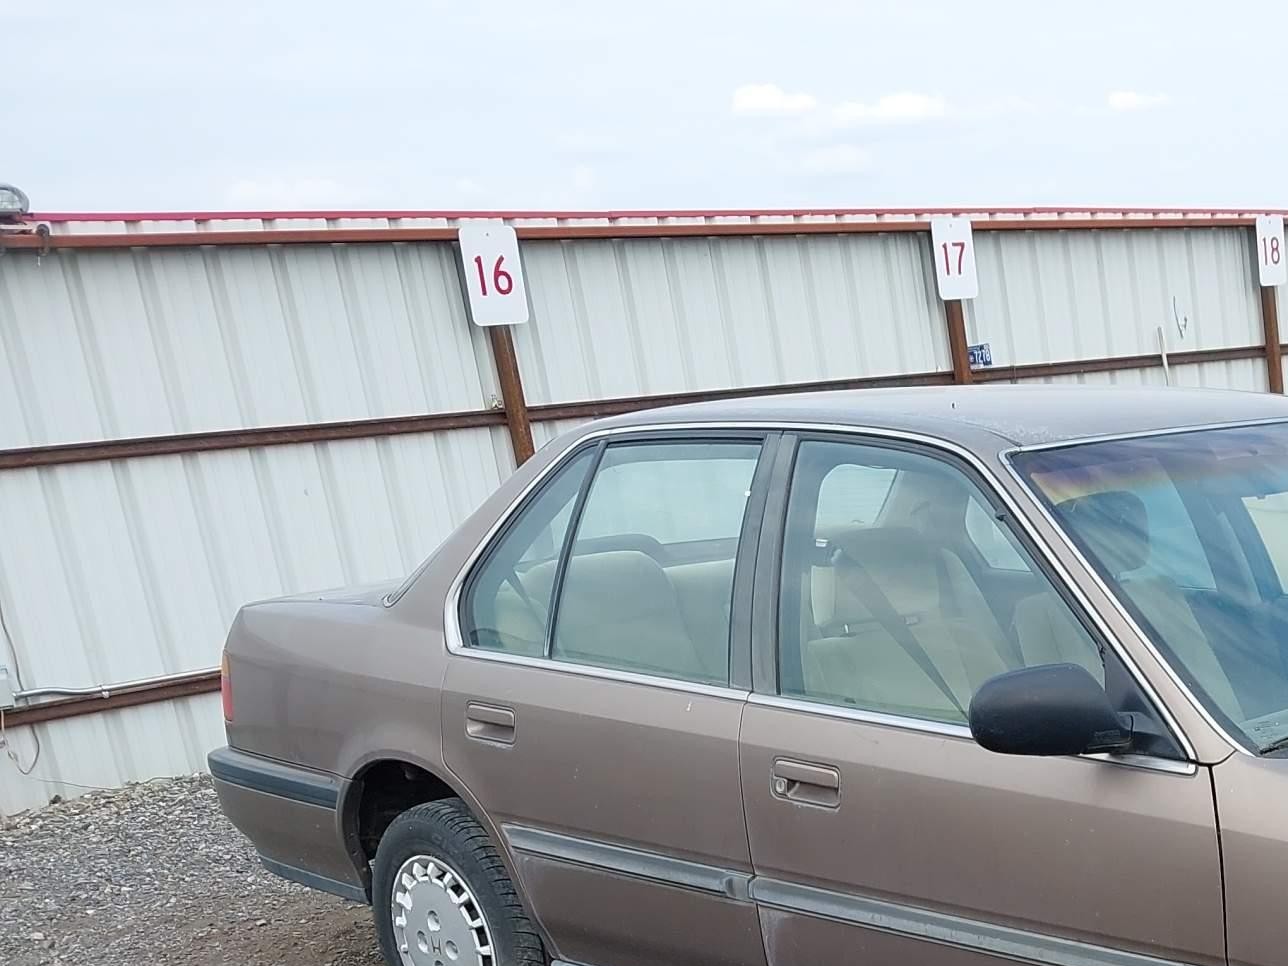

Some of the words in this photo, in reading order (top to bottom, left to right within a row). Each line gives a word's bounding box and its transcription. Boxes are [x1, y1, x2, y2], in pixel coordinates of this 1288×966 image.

[942, 242, 965, 276] 17
[1263, 236, 1280, 266] 18
[474, 255, 513, 296] 16
